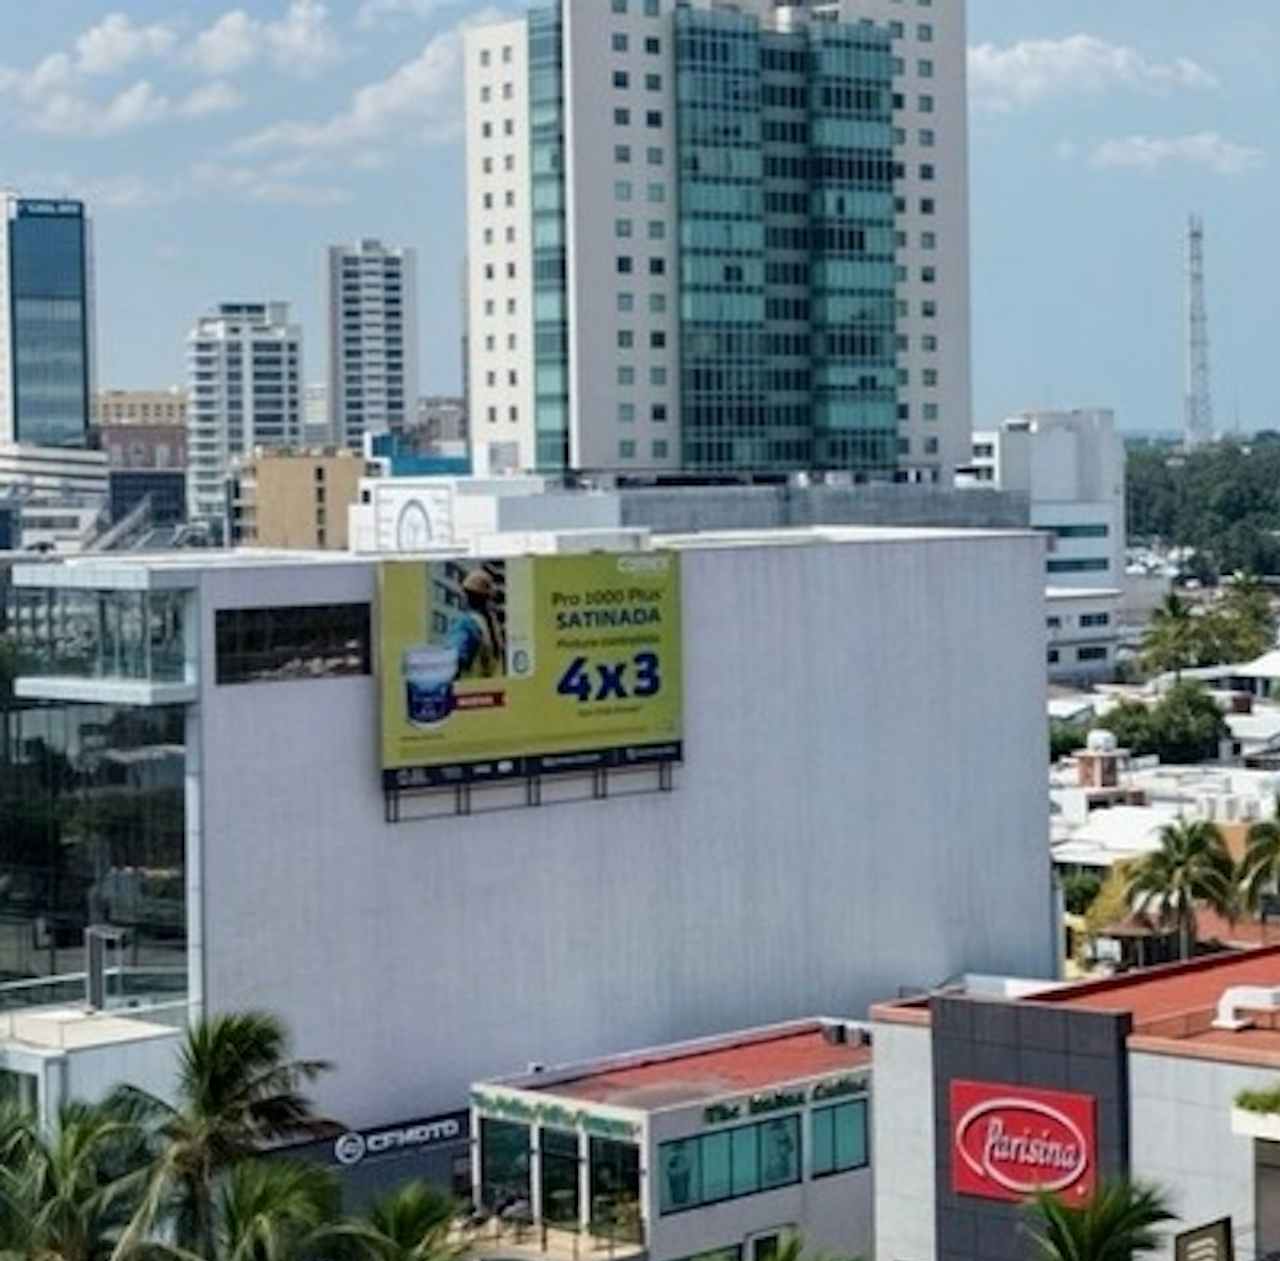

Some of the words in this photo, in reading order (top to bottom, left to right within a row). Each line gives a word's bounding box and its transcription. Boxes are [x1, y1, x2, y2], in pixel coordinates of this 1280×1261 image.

[552, 591, 579, 606] Pro
[584, 590, 623, 605] 1000
[626, 587, 662, 602] Plus
[556, 607, 662, 631] SATINADA
[556, 652, 661, 701] 4x3
[366, 1118, 459, 1151] CFMOTO
[985, 1114, 1079, 1169] Parisina
